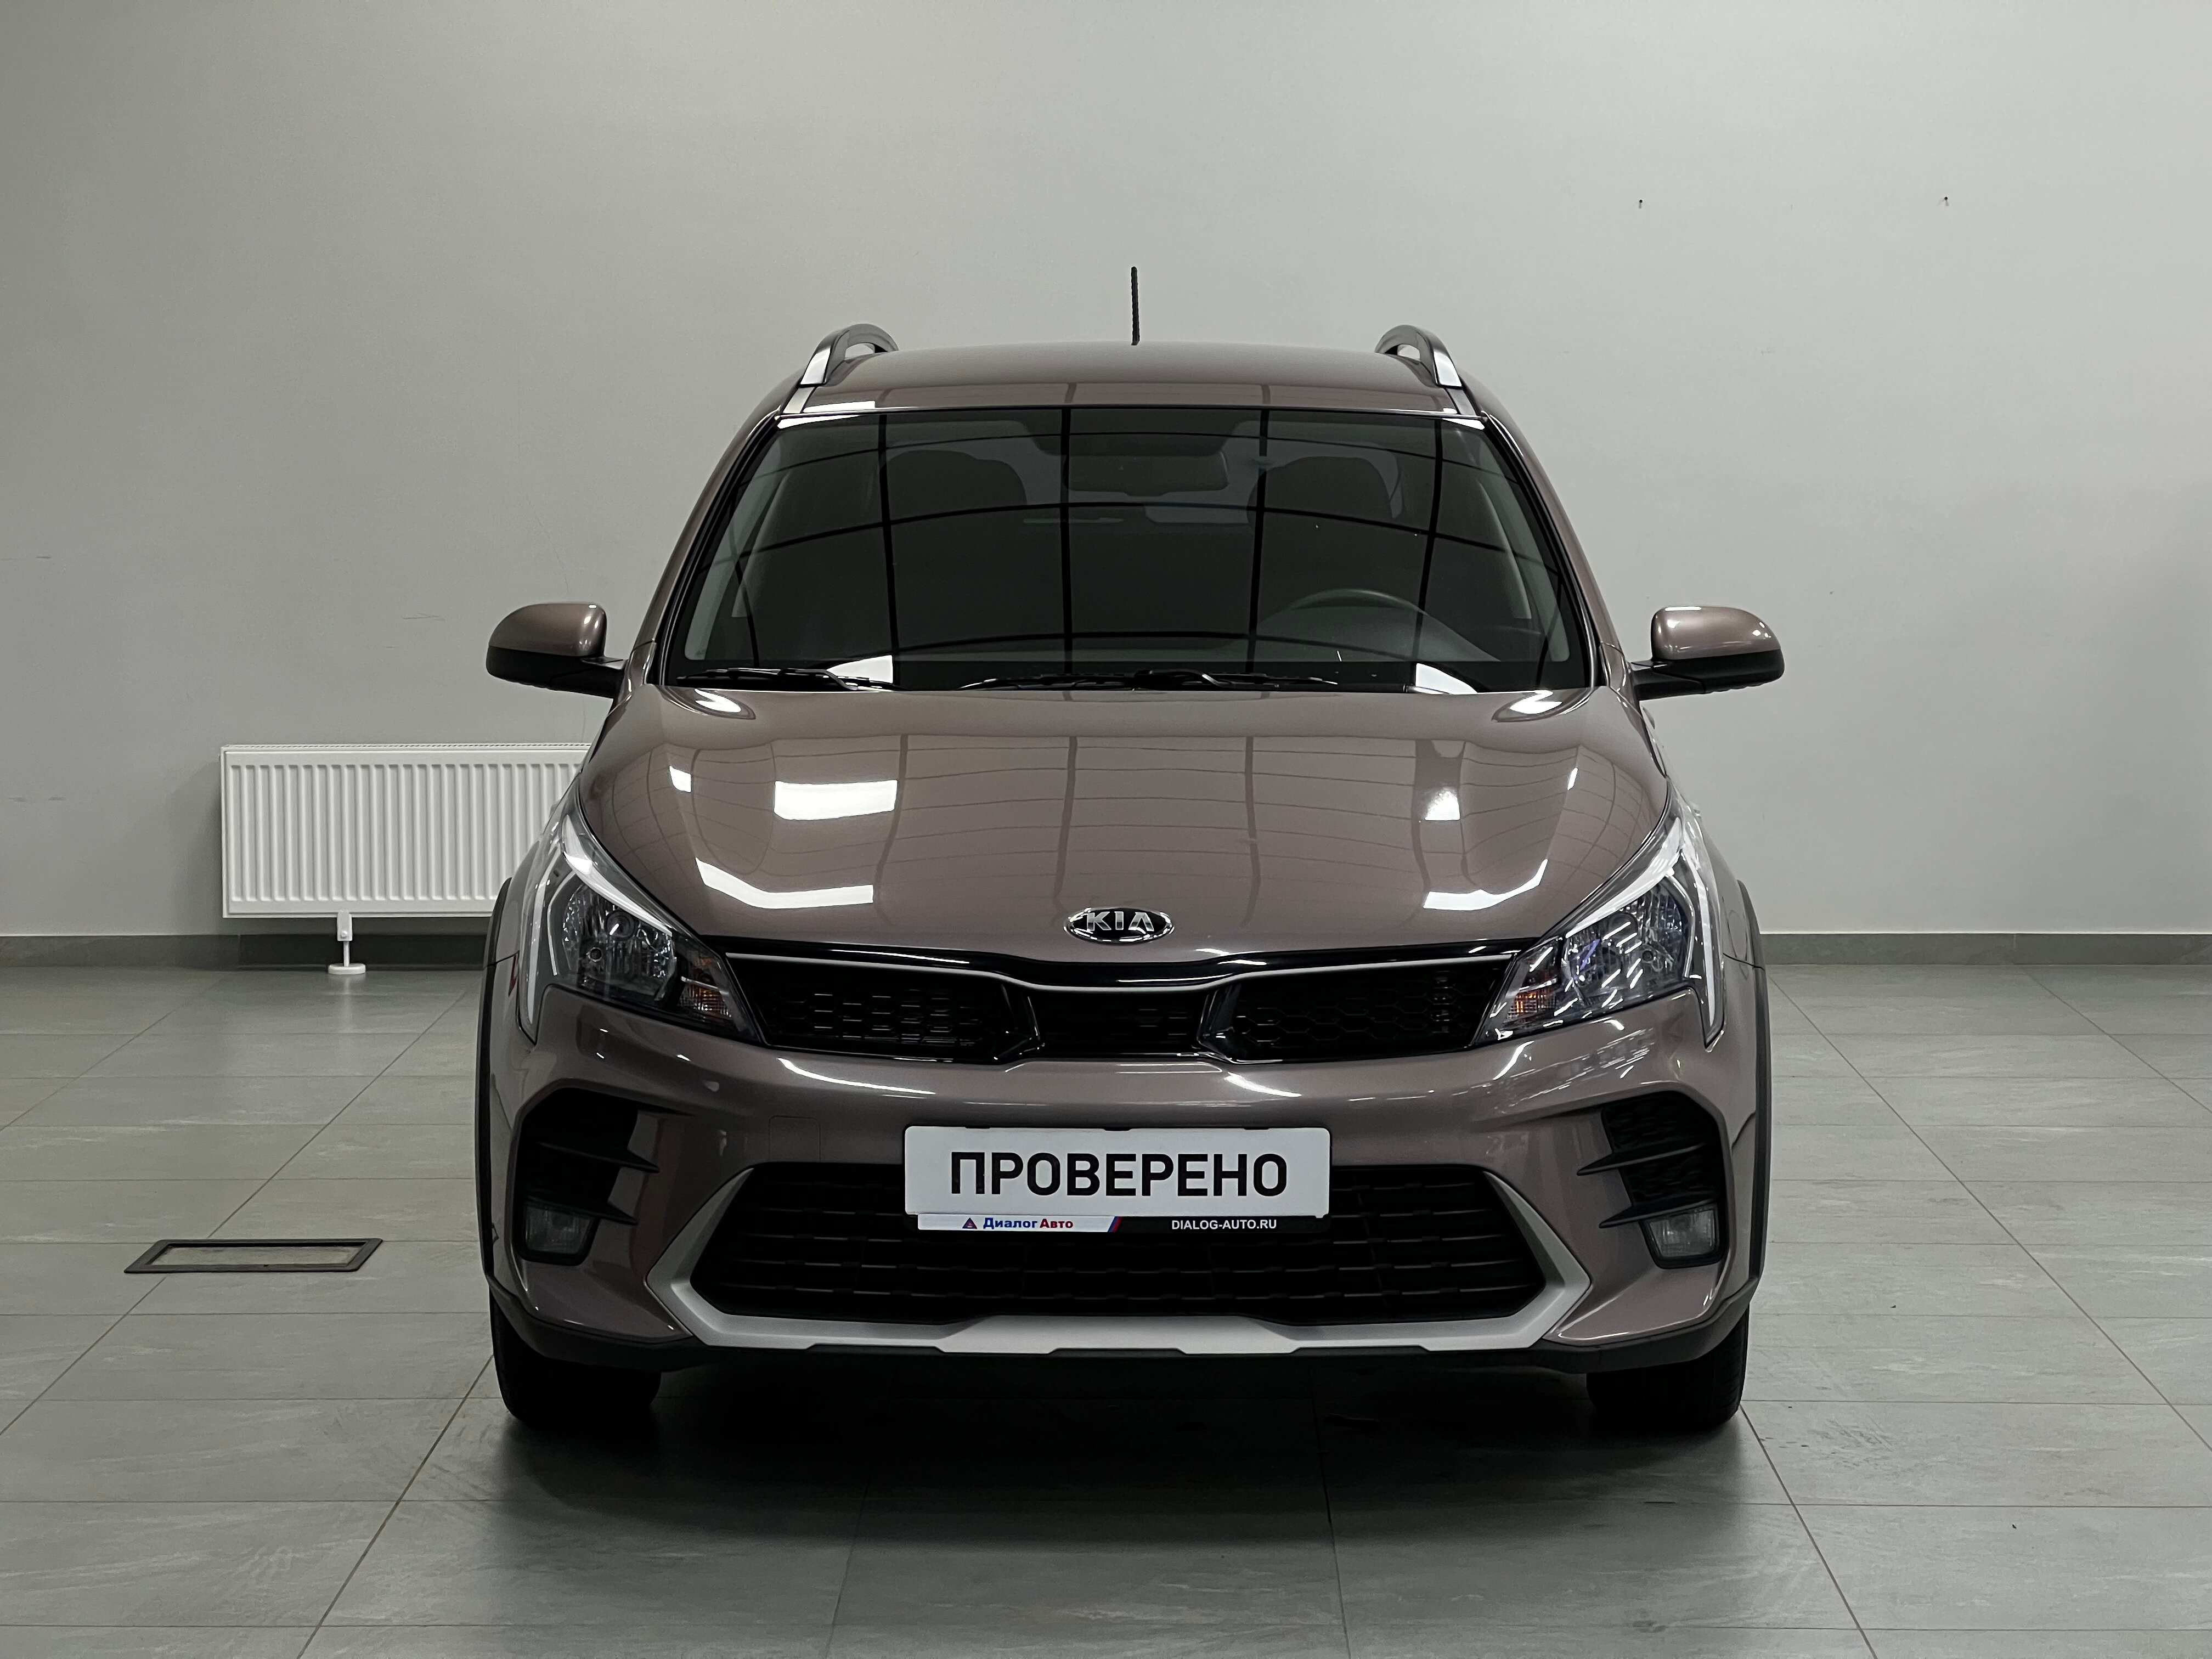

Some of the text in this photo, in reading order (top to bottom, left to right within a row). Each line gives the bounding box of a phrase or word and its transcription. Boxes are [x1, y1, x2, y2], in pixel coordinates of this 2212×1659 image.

[1086, 911, 1154, 932] KIA
[951, 1152, 1288, 1197] ПРОВЕРЕНО
[1171, 1219, 1277, 1230] DIALOG-AUTO.RU
